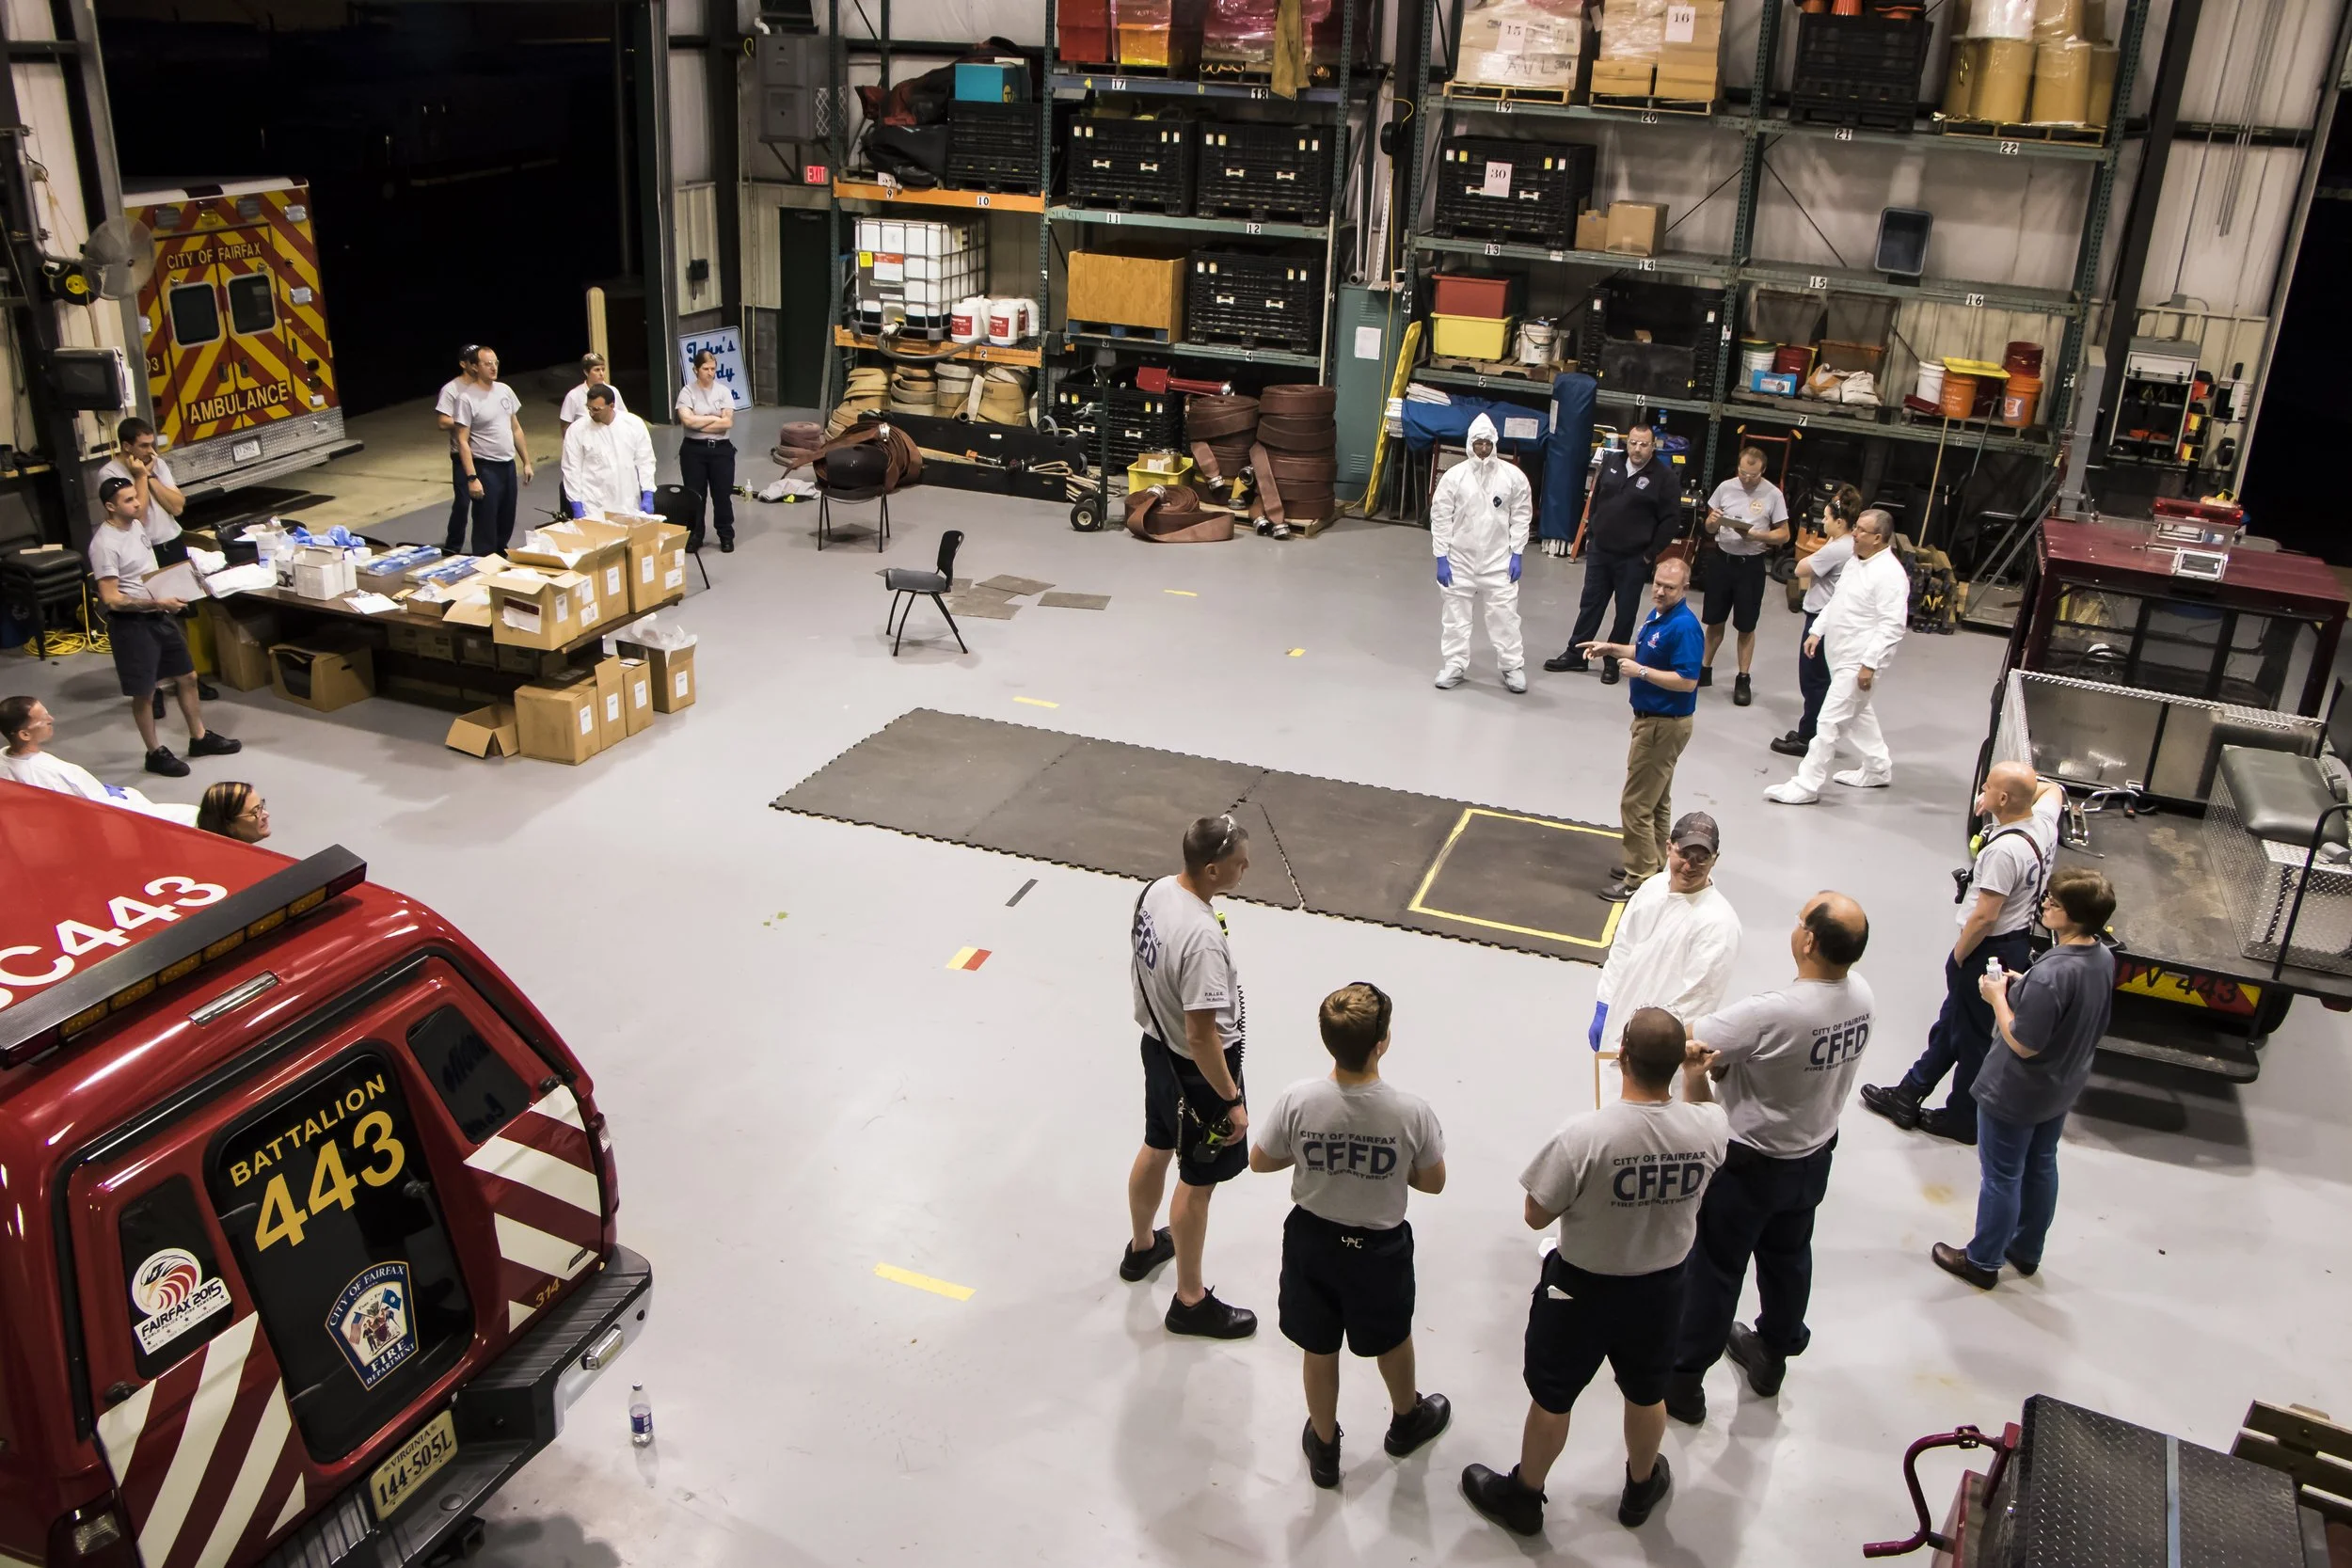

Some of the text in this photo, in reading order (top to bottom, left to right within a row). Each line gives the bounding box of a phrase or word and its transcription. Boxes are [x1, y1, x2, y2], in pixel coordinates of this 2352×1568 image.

[1674, 12, 1690, 24] 16
[1506, 24, 1521, 36] 15
[1554, 59, 1572, 71] 3M
[1113, 80, 1125, 89] 17
[1253, 88, 1268, 100] 18
[1497, 102, 1511, 112] 19
[1642, 113, 1657, 123] 20
[1836, 128, 1851, 139] 21
[2001, 142, 2018, 154] 22
[807, 165, 826, 183] EXIT
[1490, 168, 1506, 180] 30
[886, 189, 894, 198] 9
[977, 196, 990, 206] 10
[1108, 214, 1120, 223] 11
[1248, 224, 1260, 234] 12
[167, 242, 262, 270] CITY OF FAIRFAX
[1486, 245, 1500, 255] 13
[1640, 260, 1655, 271] 14
[1810, 277, 1826, 288] 15
[1966, 294, 1983, 306] 16
[686, 336, 737, 363] Jhn's
[980, 350, 987, 358] 2
[1246, 351, 1253, 361] 4
[1479, 377, 1486, 387] 5
[190, 382, 289, 424] AMBULANCE
[1637, 395, 1645, 405] 6
[1800, 415, 1806, 425] 7
[0, 876, 228, 1010] C443
[2175, 974, 2239, 1005] 443
[1812, 1013, 1870, 1037] CITY OF FAIRFAX
[1810, 1022, 1869, 1066] CFFD
[230, 1074, 386, 1187] BATTALION
[1300, 1130, 1396, 1145] CITY OF FAIRFAX
[1303, 1141, 1397, 1175] CFFD
[1613, 1151, 1706, 1166] CITY OF FAIRFAX
[255, 1110, 405, 1253] 443
[1613, 1163, 1706, 1201] CFFD
[329, 1296, 348, 1326] CITY
[349, 1281, 361, 1296] OF
[364, 1265, 405, 1285] FAIRFAX
[535, 1277, 561, 1308] 314
[141, 1298, 191, 1338] FAIRFAX
[192, 1279, 222, 1306] 2015
[162, 1318, 179, 1330] POLICE
[371, 1339, 407, 1372] FIRE
[366, 1342, 415, 1385] DEPARTMENT
[390, 1430, 431, 1466] VIRGINIA
[378, 1429, 453, 1507] 144-505L
